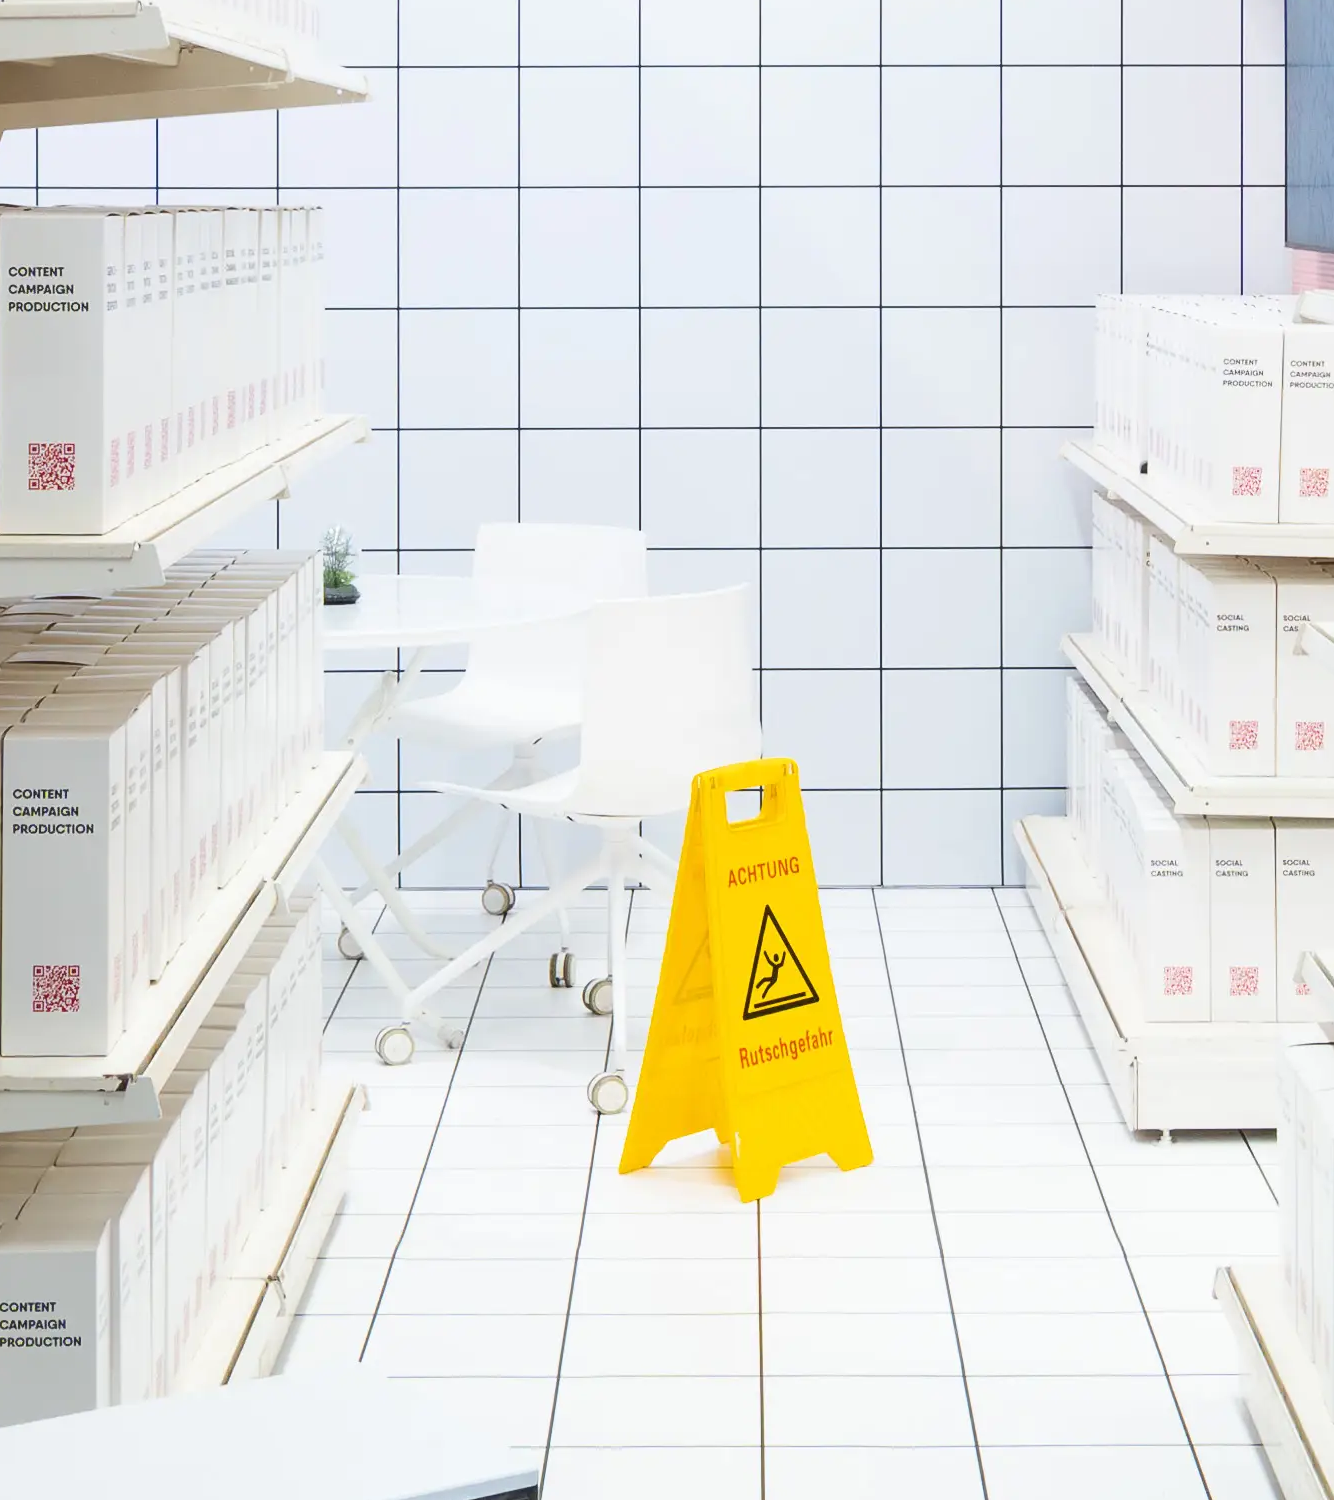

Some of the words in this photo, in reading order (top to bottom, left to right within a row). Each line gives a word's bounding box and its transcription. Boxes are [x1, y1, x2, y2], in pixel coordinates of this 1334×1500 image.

[8, 266, 64, 277] CONTENT
[8, 284, 74, 294] CAMPAIGN
[8, 301, 89, 312] PRODUCTION
[1290, 359, 1324, 367] CONTENT
[1222, 368, 1263, 376] CAMPAIGN
[1289, 370, 1330, 378] CAMPAIGN
[1222, 379, 1272, 387] PRODUCTION
[12, 788, 69, 799] CONTENT
[12, 806, 79, 816] CAMPAIGN
[12, 823, 94, 834] PRODUCTION
[728, 856, 801, 888] ACHTUNG
[1215, 869, 1248, 877] CASTING
[739, 1027, 834, 1069] Rutschgefahr
[0, 1319, 66, 1330] CAMPAIGN
[0, 1336, 81, 1347] PRODUCTION
